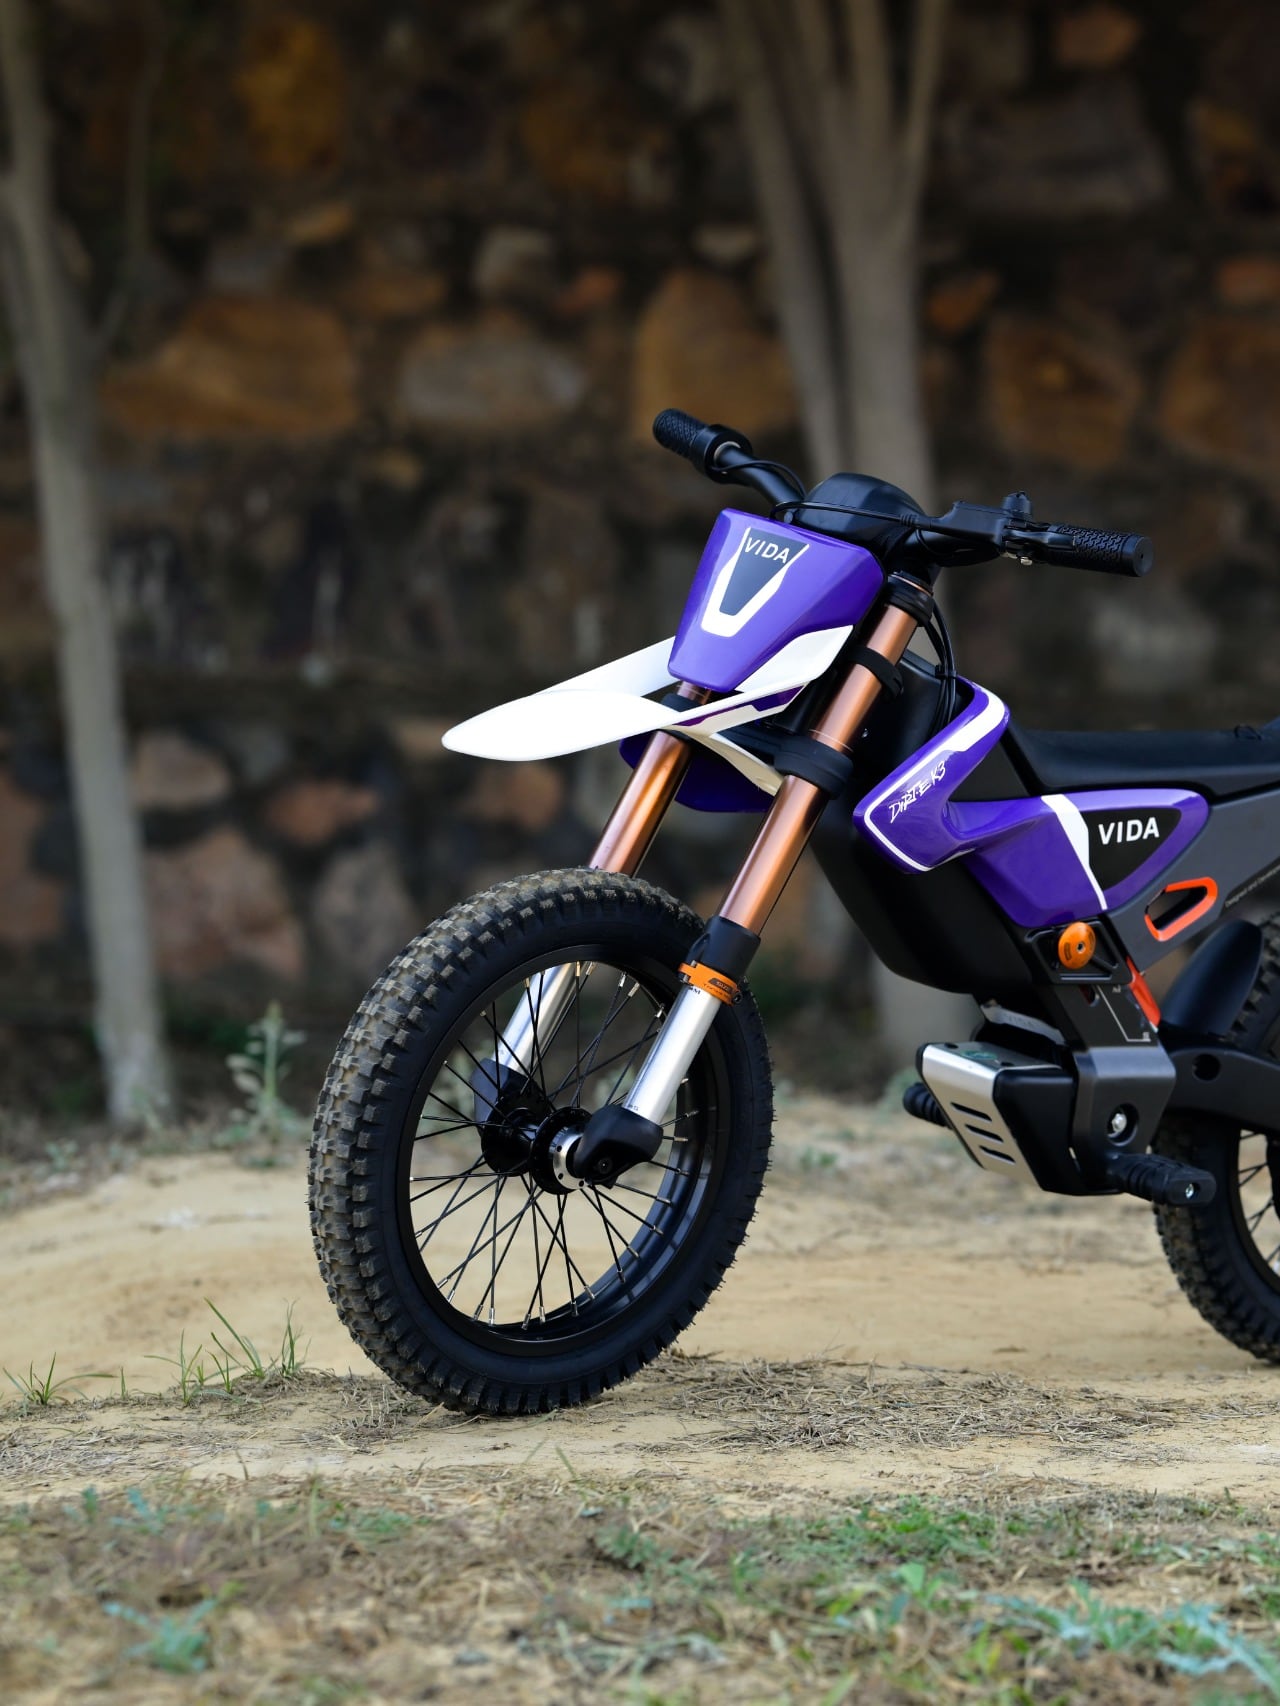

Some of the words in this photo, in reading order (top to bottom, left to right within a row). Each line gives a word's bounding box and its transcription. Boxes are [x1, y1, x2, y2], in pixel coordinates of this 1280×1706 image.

[745, 537, 790, 564] VIDA
[930, 760, 946, 786] K3
[1098, 816, 1160, 845] VIDA
